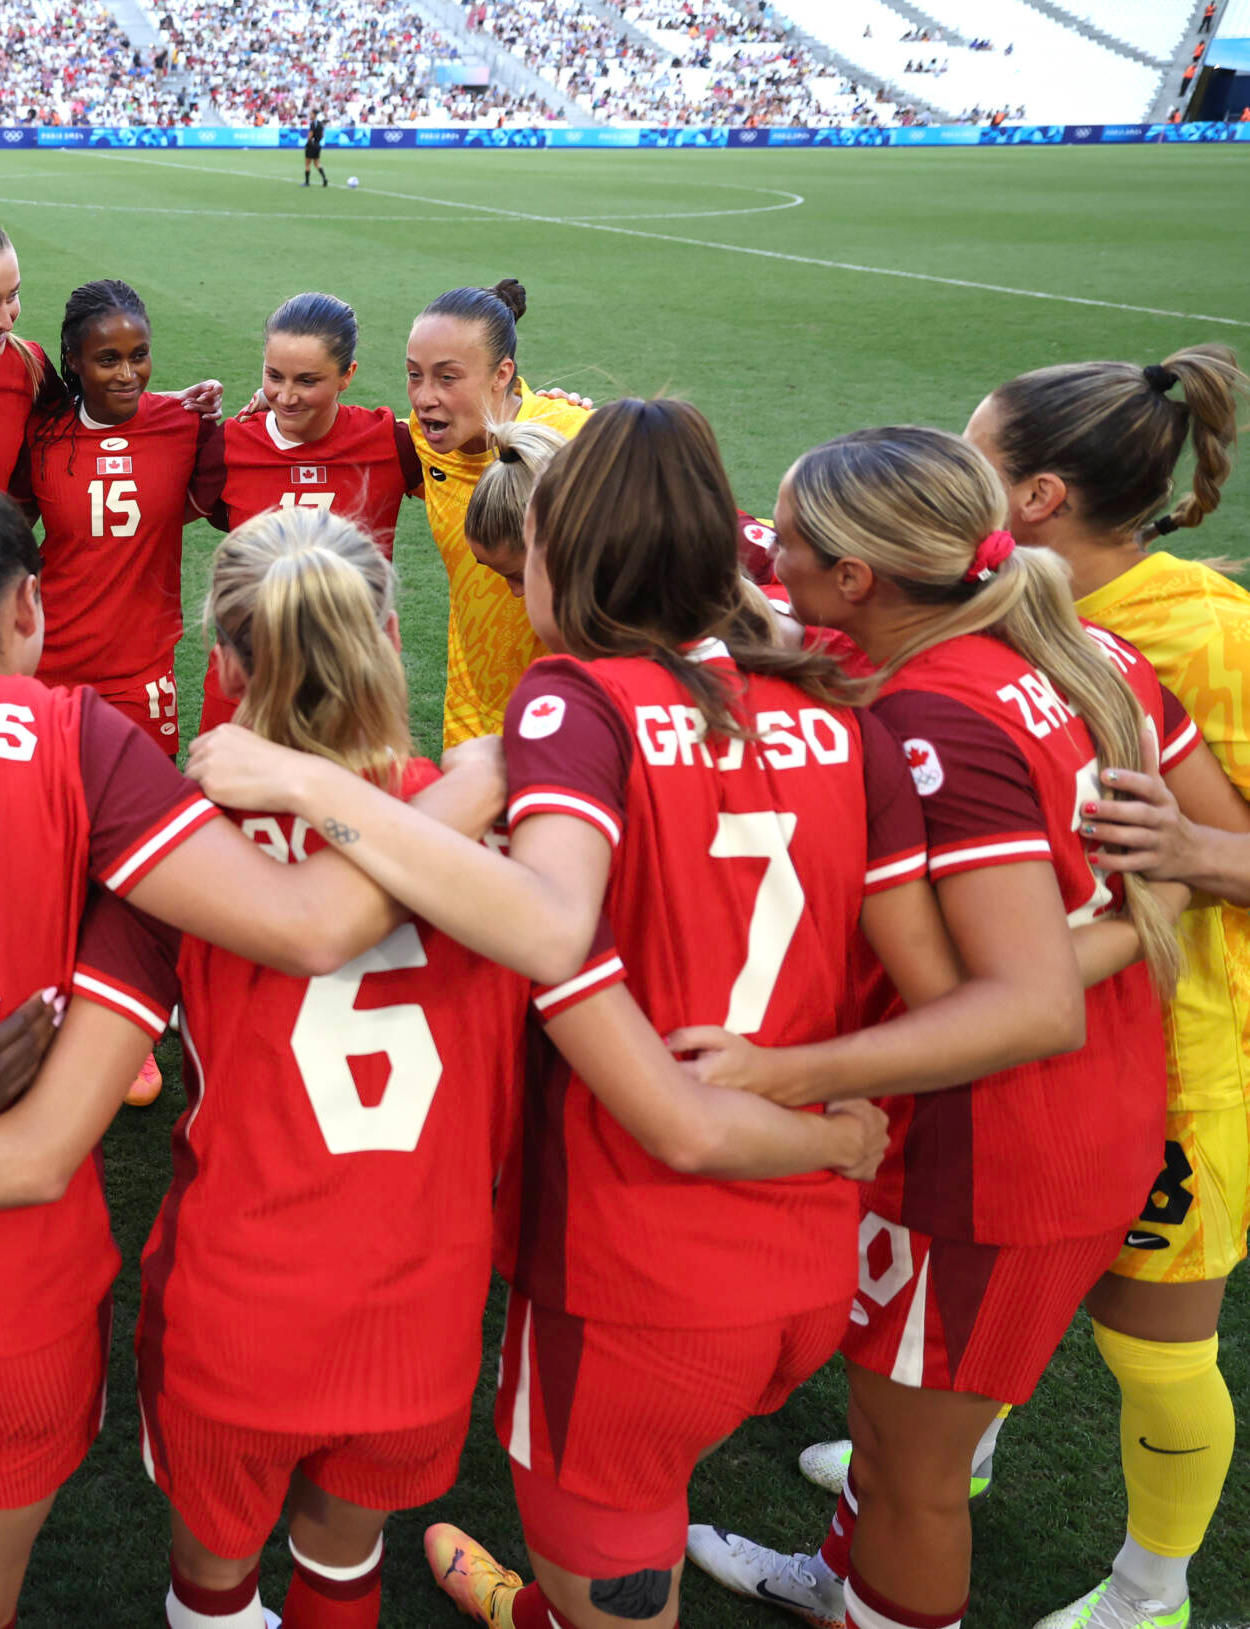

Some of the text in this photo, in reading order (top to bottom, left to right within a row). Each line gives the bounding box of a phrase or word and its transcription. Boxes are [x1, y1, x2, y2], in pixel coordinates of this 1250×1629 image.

[88, 480, 142, 538] 15
[634, 704, 849, 772] GRSO
[709, 811, 805, 1035] 7
[290, 922, 443, 1155] 6
